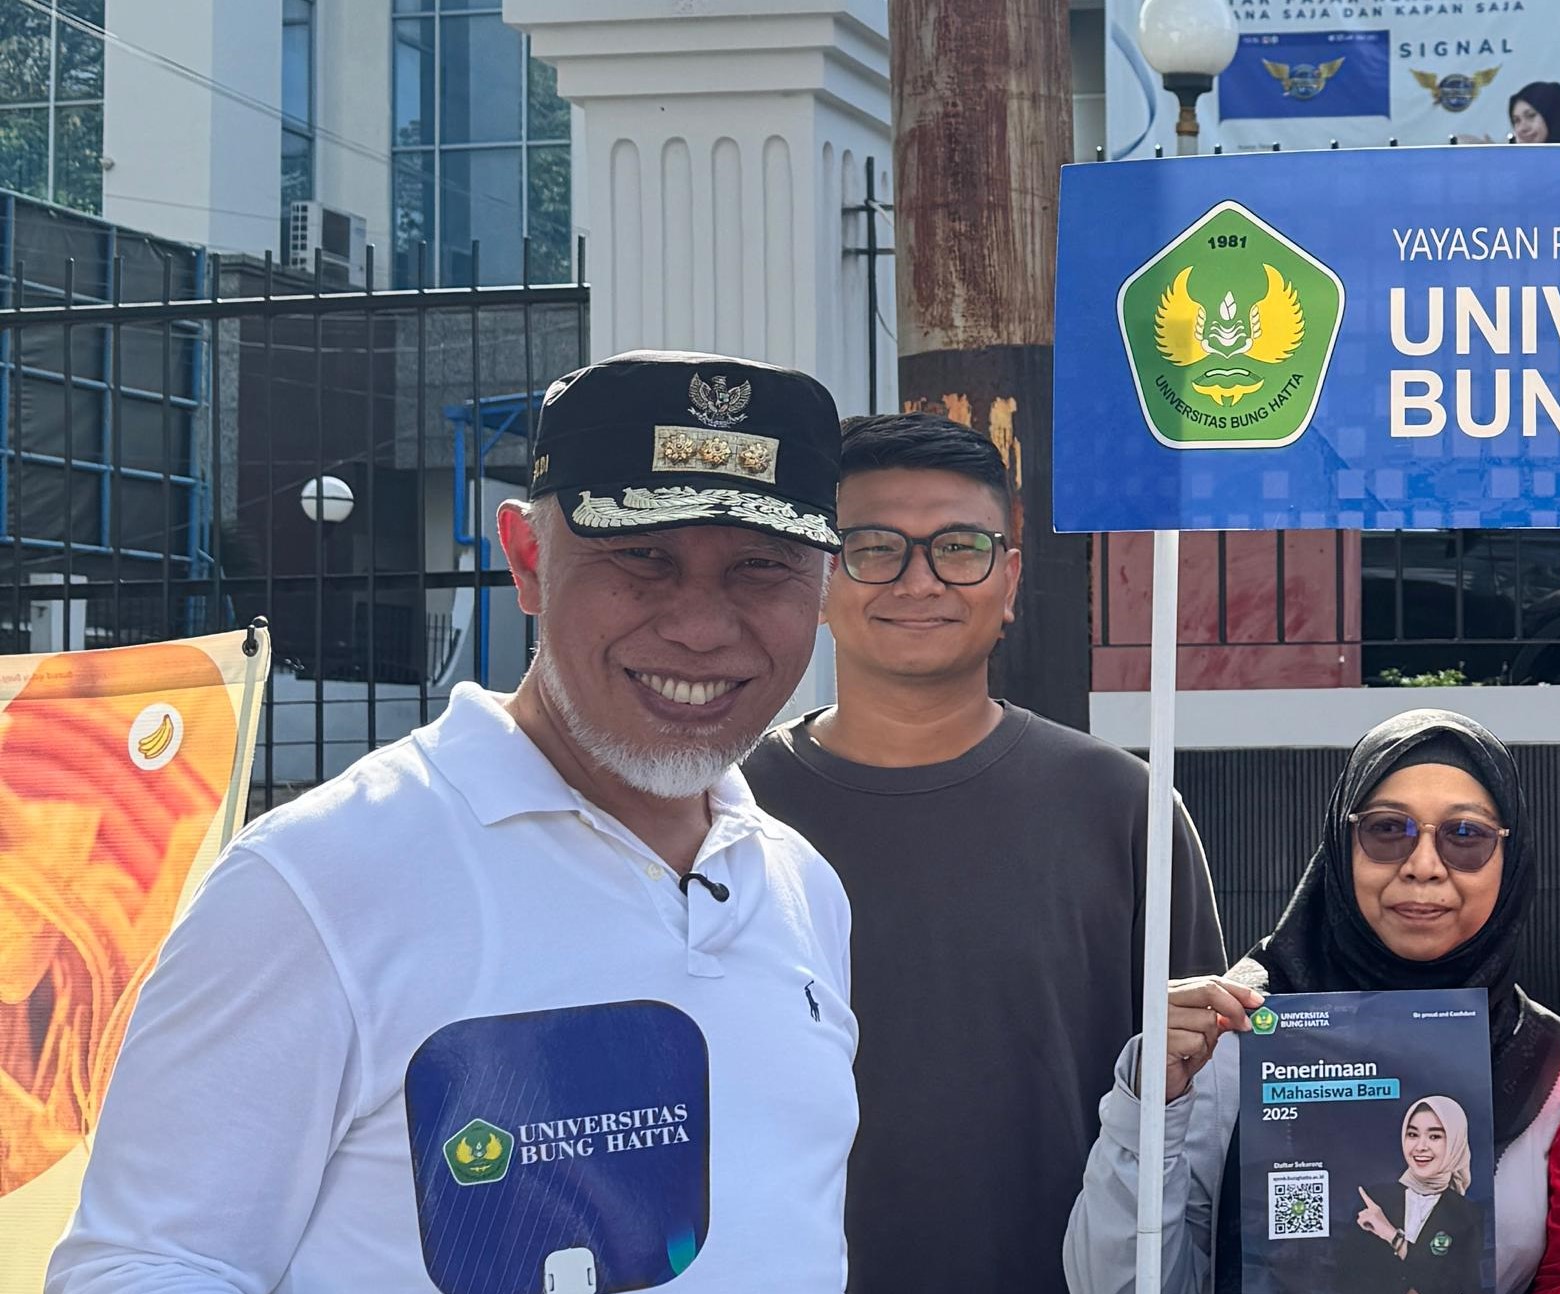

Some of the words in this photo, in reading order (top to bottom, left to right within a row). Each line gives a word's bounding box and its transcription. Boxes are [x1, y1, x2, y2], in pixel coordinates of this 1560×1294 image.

[1283, 8, 1330, 20] SAJA
[1343, 7, 1383, 18] DAN
[1395, 4, 1463, 16] KAPAN
[1476, 1, 1525, 13] SAJA
[1399, 37, 1515, 59] SIGNAL
[1208, 235, 1248, 250] 1981
[1393, 227, 1540, 262] YAYASAN
[1155, 374, 1227, 428] UNIVERSITAS
[1231, 408, 1269, 429] BUNG
[1270, 373, 1304, 412] HATTA
[1281, 1012, 1329, 1020] UNIVERSITAS
[1281, 1020, 1303, 1028] BUNG
[1304, 1019, 1329, 1027] HATTA
[1261, 1060, 1377, 1080] Penerimaan
[1271, 1085, 1353, 1100] Mahasiswa
[1357, 1083, 1391, 1097] Baru
[518, 1104, 689, 1143] UNIVERSITAS
[1262, 1107, 1298, 1121] 2025
[520, 1138, 594, 1165] BUNG
[606, 1124, 690, 1154] HATTA
